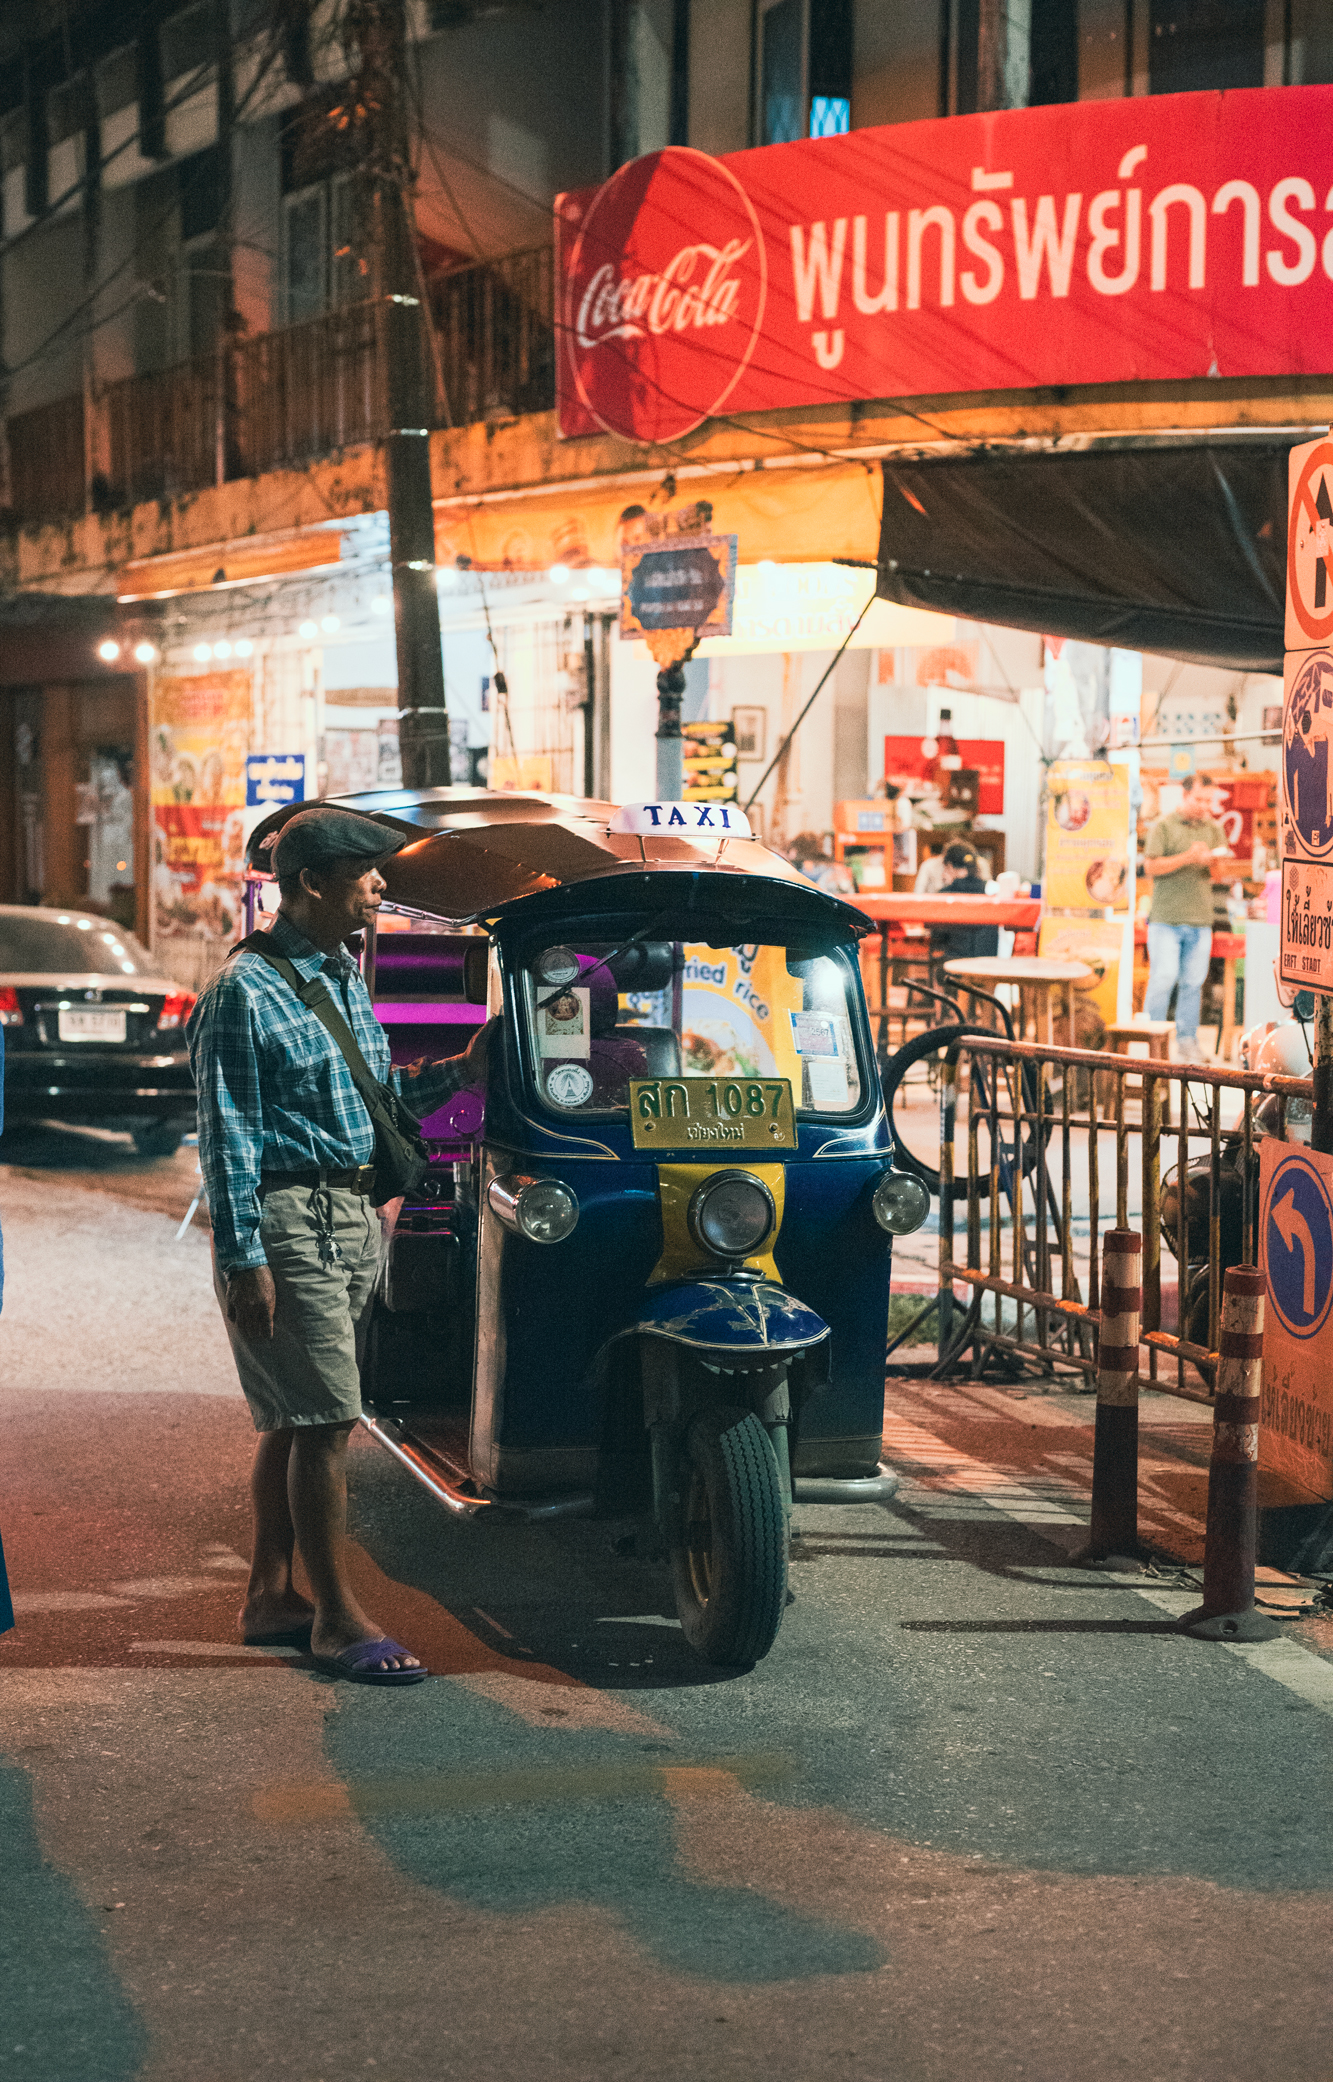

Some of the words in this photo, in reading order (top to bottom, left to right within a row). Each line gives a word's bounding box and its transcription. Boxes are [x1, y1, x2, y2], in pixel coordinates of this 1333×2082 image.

[577, 237, 754, 348] Coca-Cola
[643, 805, 731, 828] TAXI
[1286, 885, 1333, 950] ให้เลี้ยวซ้
[684, 958, 725, 984] ried
[735, 982, 769, 1019] rice
[637, 1081, 690, 1118] สก
[705, 1083, 784, 1117] 1087
[687, 1122, 745, 1140] เชียงใหม่
